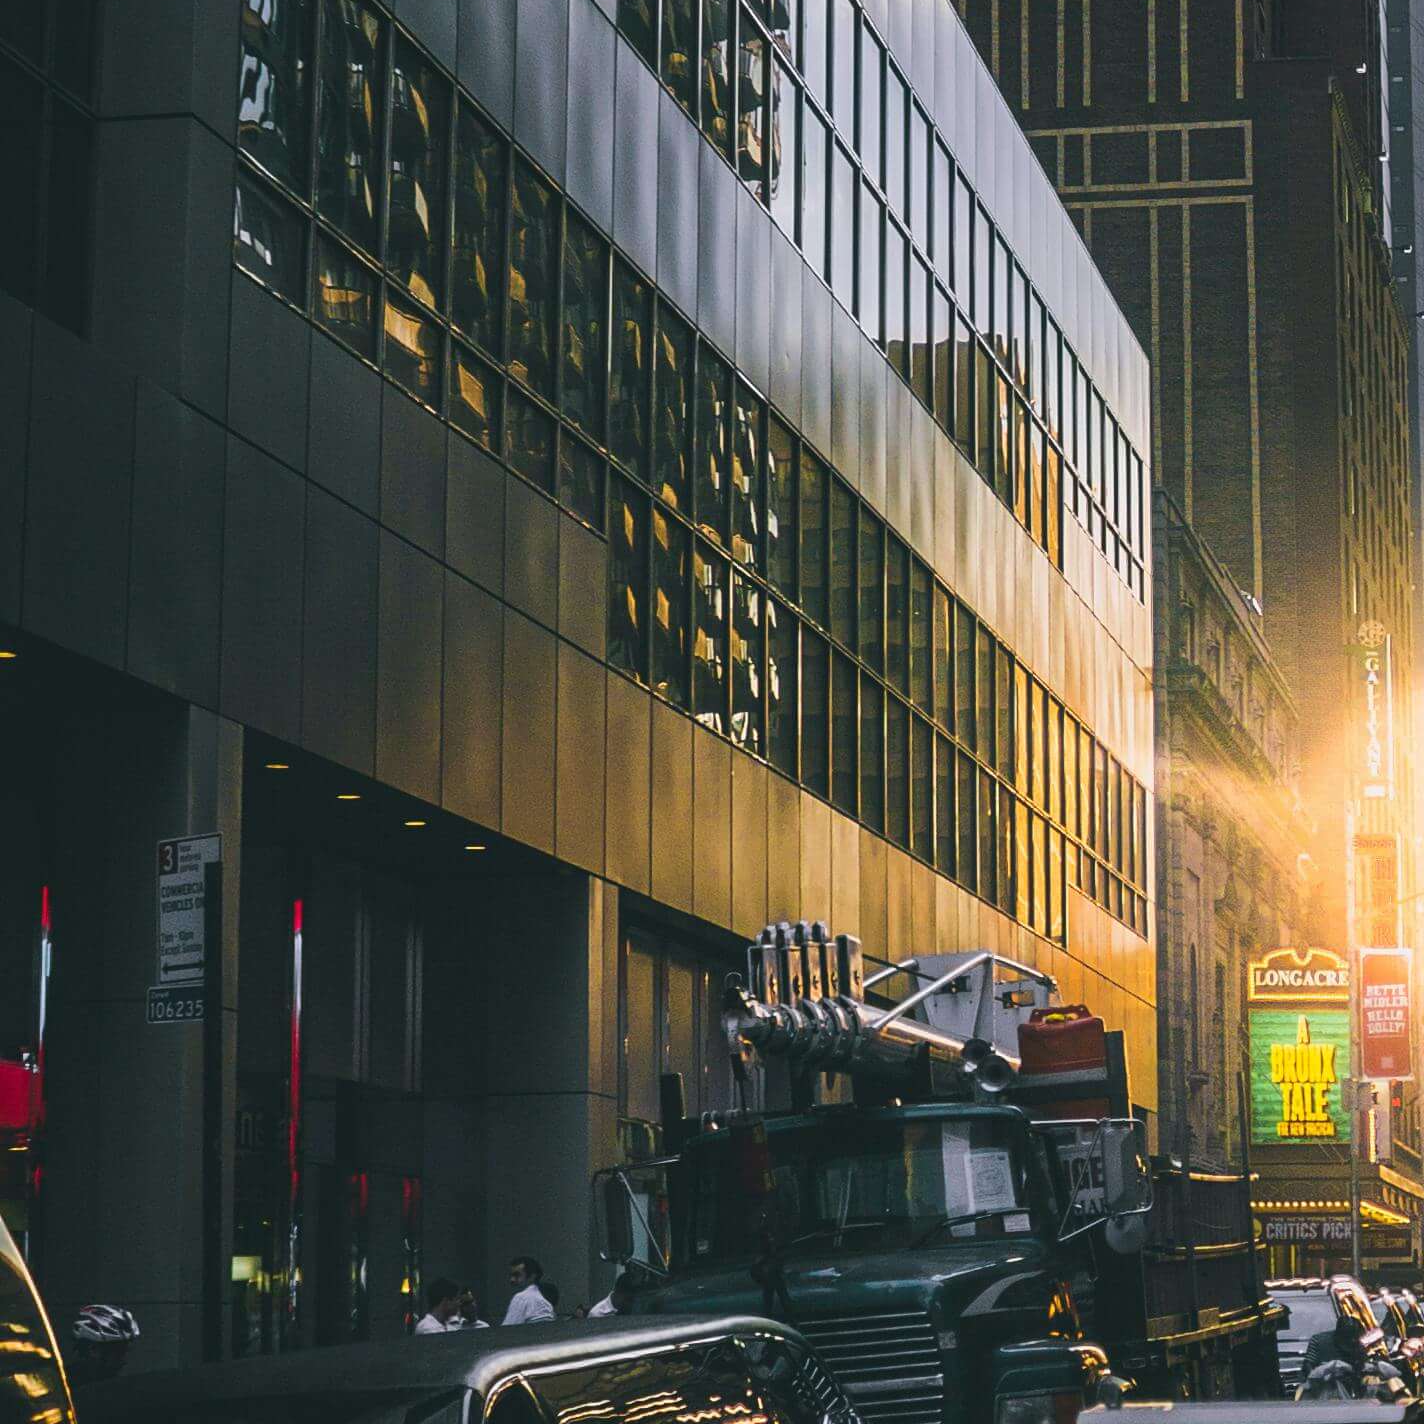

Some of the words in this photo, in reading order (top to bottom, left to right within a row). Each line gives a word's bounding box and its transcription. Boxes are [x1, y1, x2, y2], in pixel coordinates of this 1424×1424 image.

[163, 845, 173, 871] 3
[161, 881, 204, 898] COMMERCIA
[1255, 969, 1349, 987] LONGACRE
[151, 1000, 204, 1019] 106235
[1297, 1014, 1310, 1043] A
[1271, 1043, 1336, 1083] BRONX
[1280, 1082, 1331, 1121] TALE
[1322, 1221, 1352, 1239] PICK
